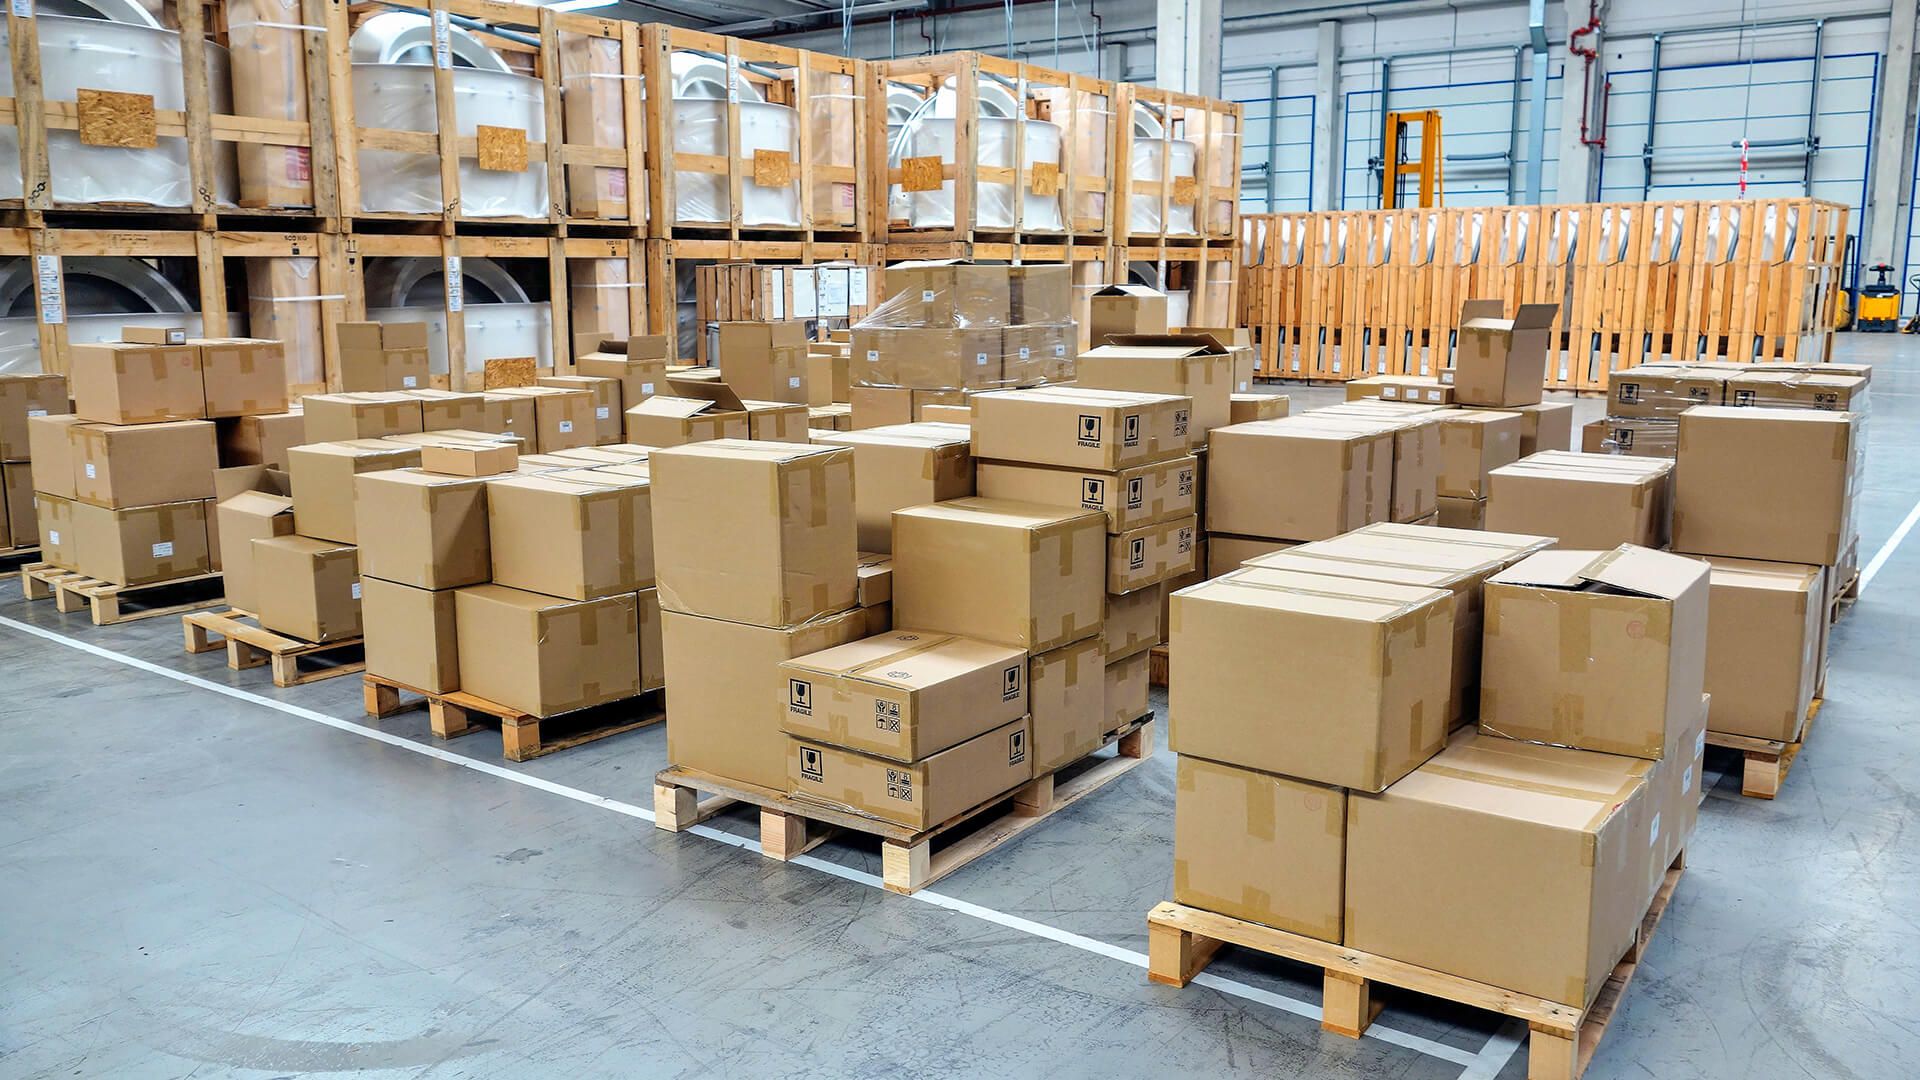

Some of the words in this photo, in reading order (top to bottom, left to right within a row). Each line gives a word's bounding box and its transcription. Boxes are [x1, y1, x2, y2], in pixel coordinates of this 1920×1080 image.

[1077, 441, 1101, 449] FRAGILE
[1081, 503, 1104, 511] FRAGILE
[1003, 692, 1020, 703] FRAGILE
[790, 706, 812, 716] FRAGILE
[801, 773, 823, 783] FRAGILE
